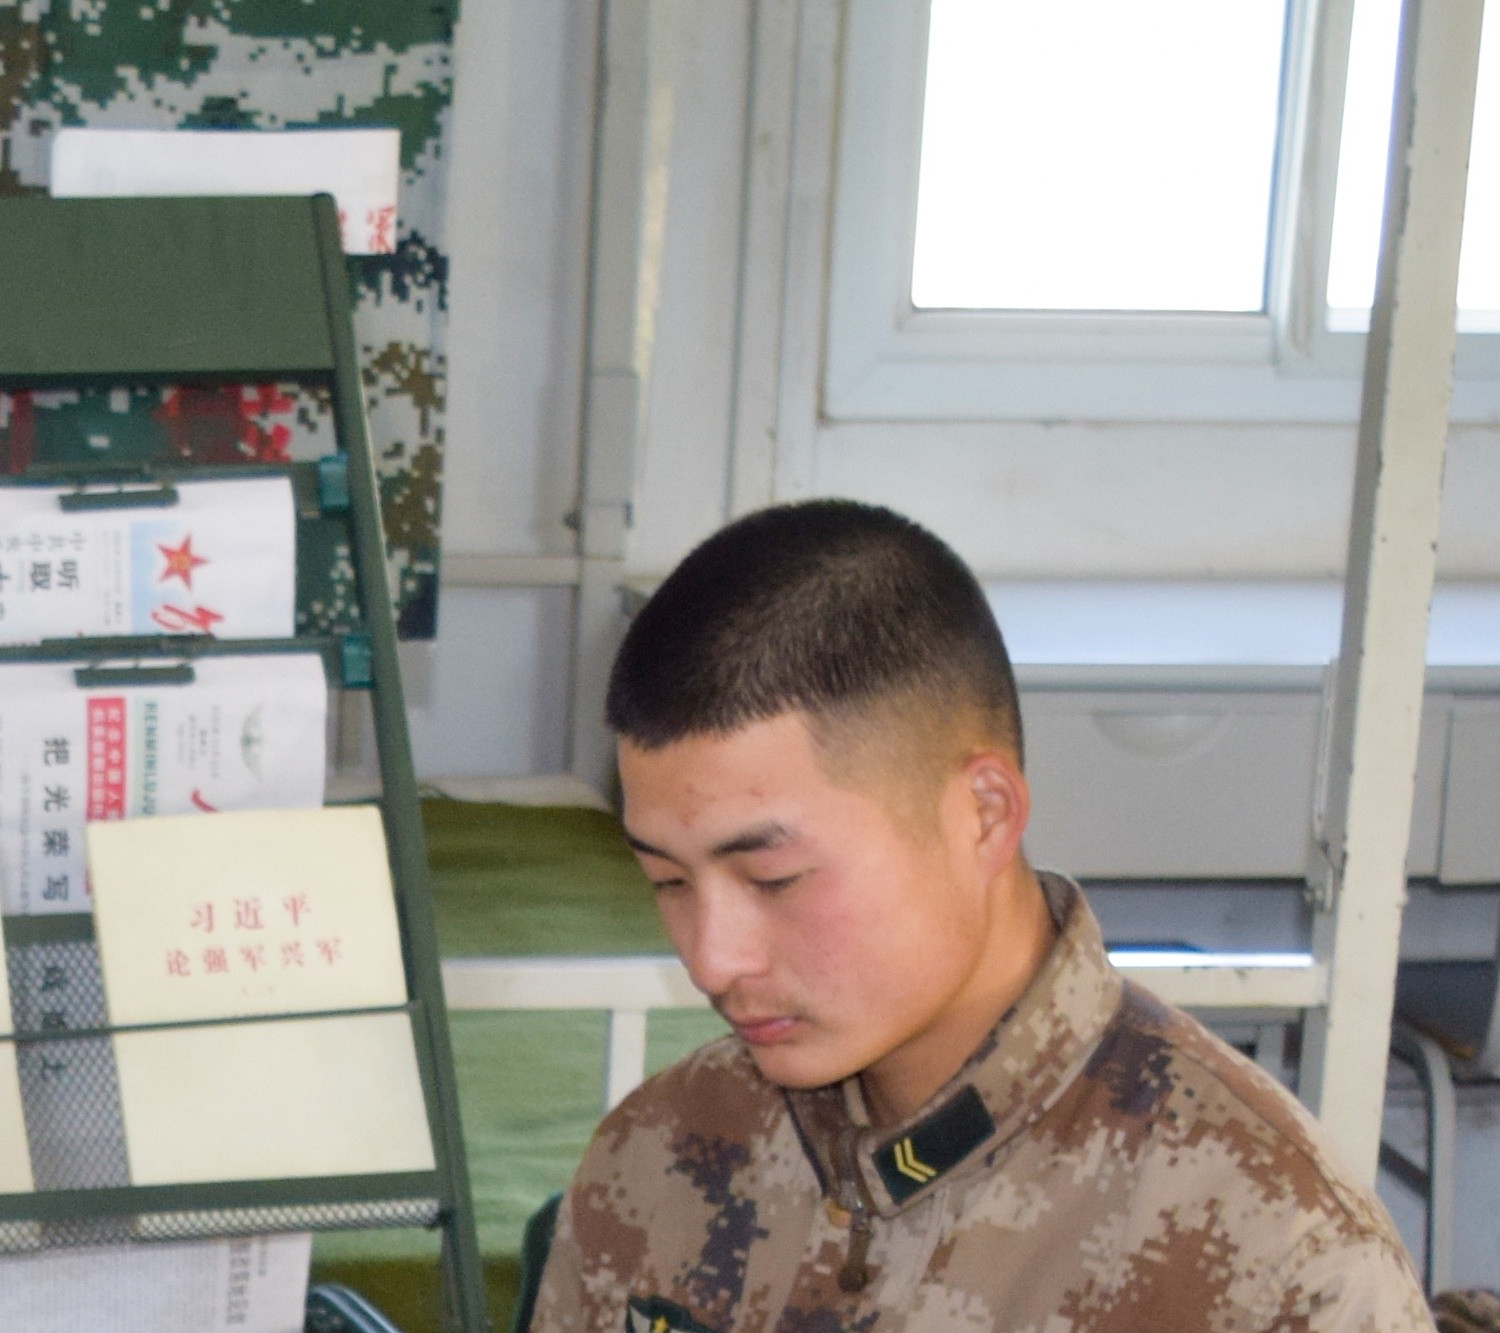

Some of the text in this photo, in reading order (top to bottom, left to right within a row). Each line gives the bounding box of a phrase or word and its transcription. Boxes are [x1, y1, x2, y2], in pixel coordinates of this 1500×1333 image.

[189, 893, 311, 933] 习近平
[166, 936, 342, 977] 论强军兴军
